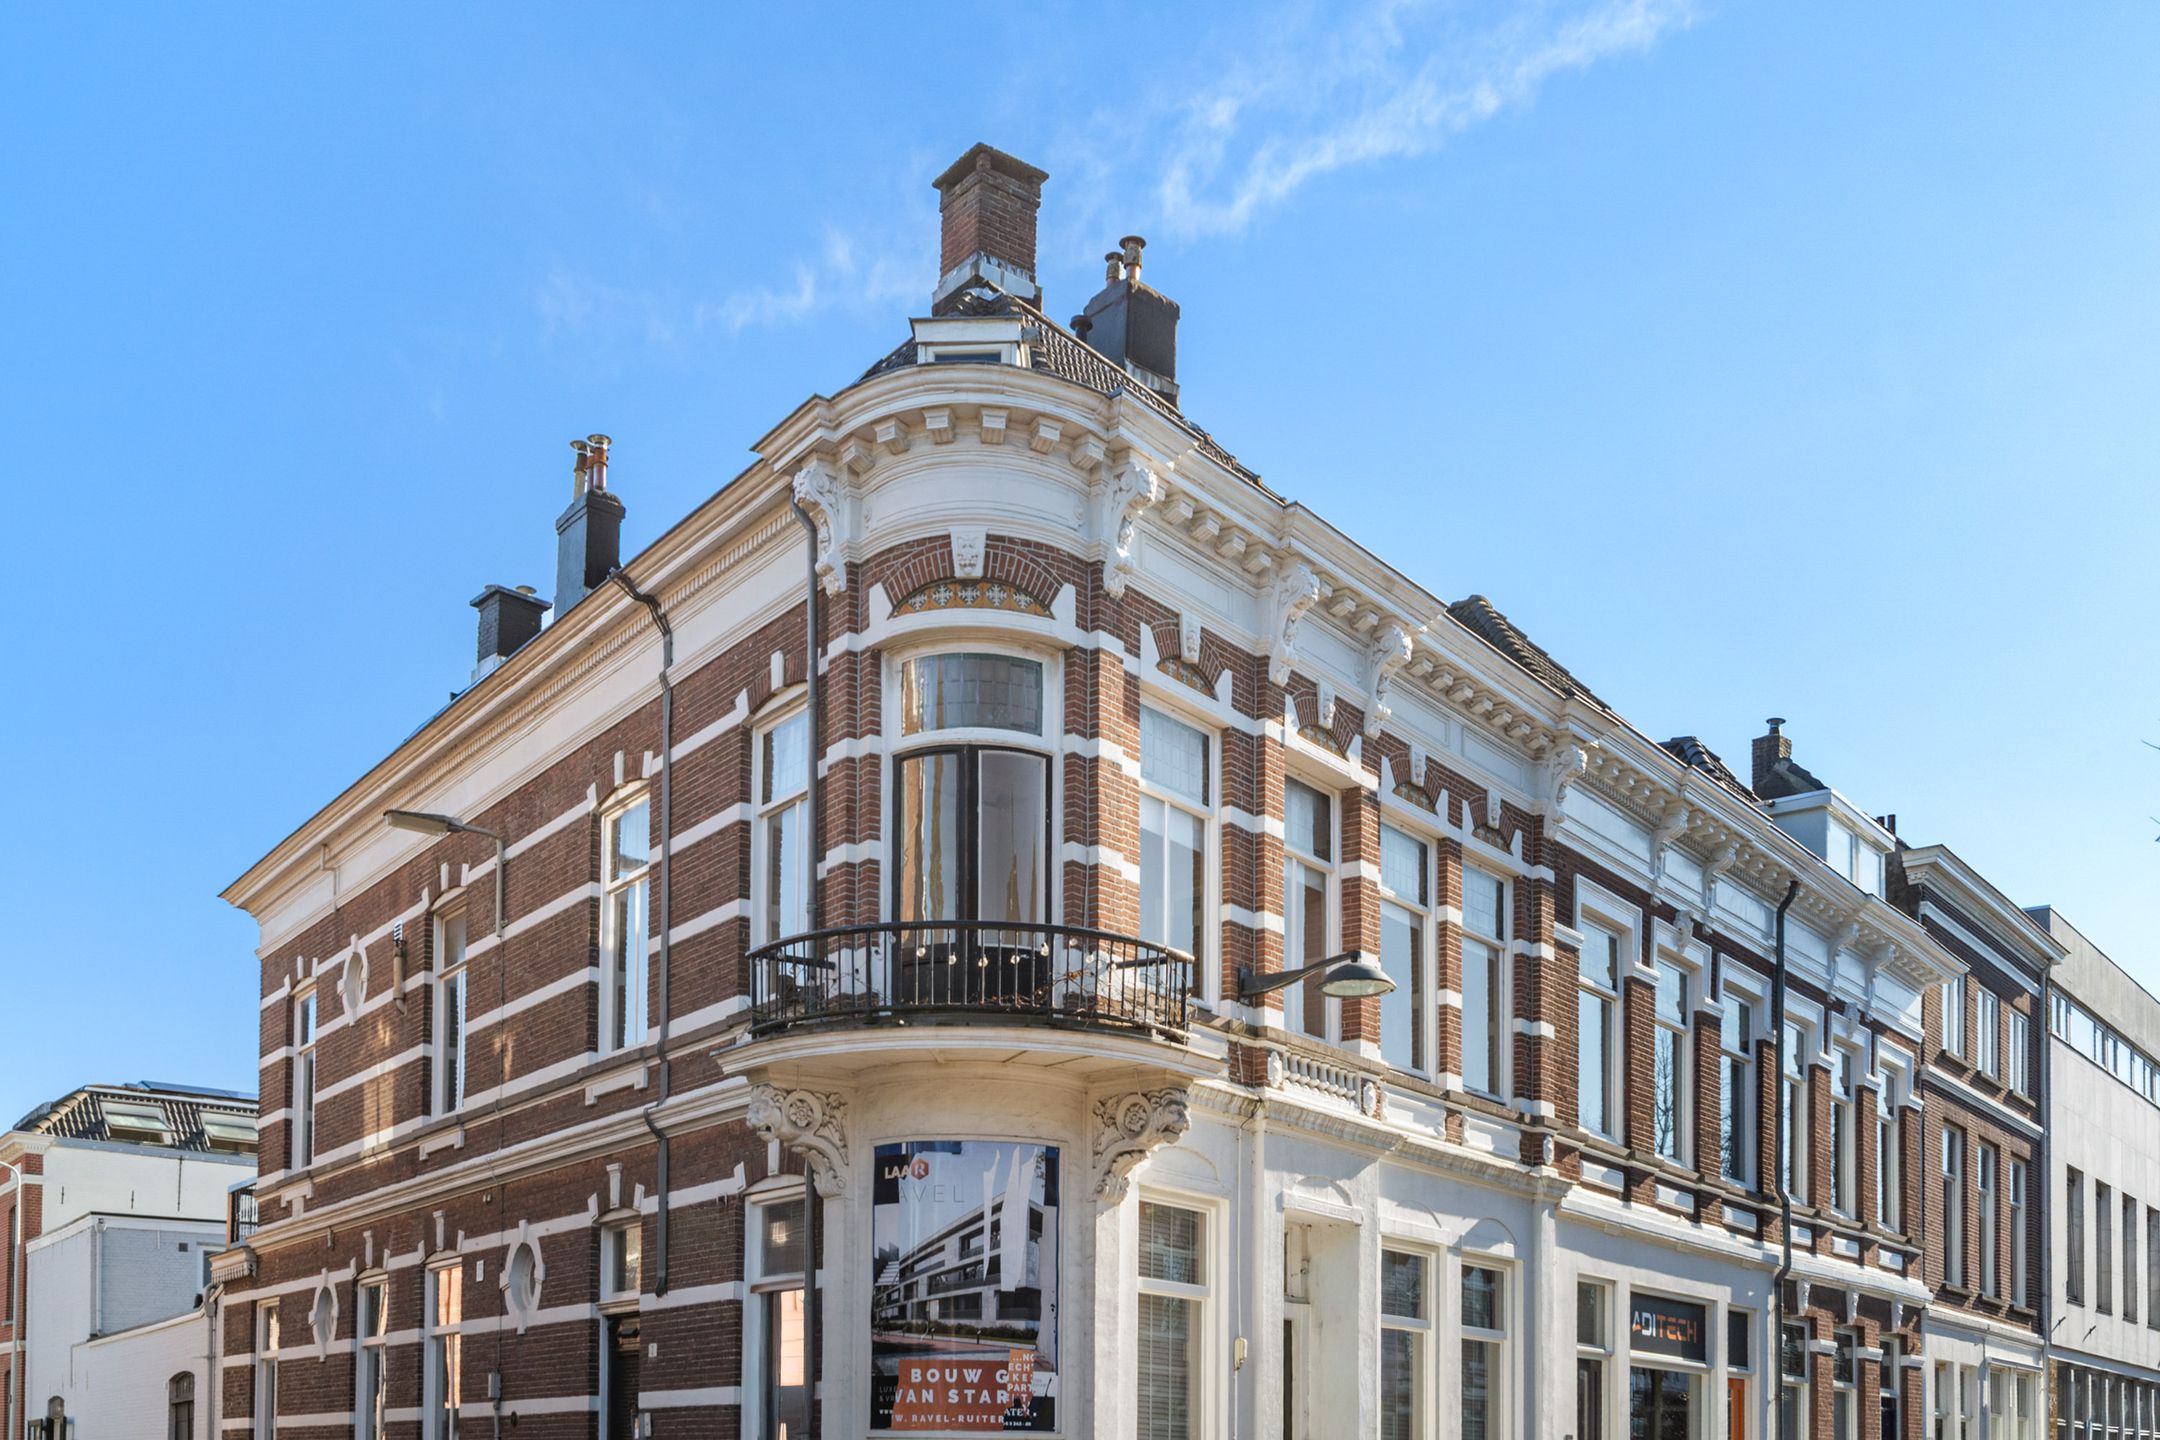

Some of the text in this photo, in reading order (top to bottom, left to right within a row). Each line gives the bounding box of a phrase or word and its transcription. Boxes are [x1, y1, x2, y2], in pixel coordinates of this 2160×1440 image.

[1632, 1310, 1697, 1344] ADITECH
[911, 1367, 983, 1384] BOUW
[895, 1388, 934, 1404] VAN
